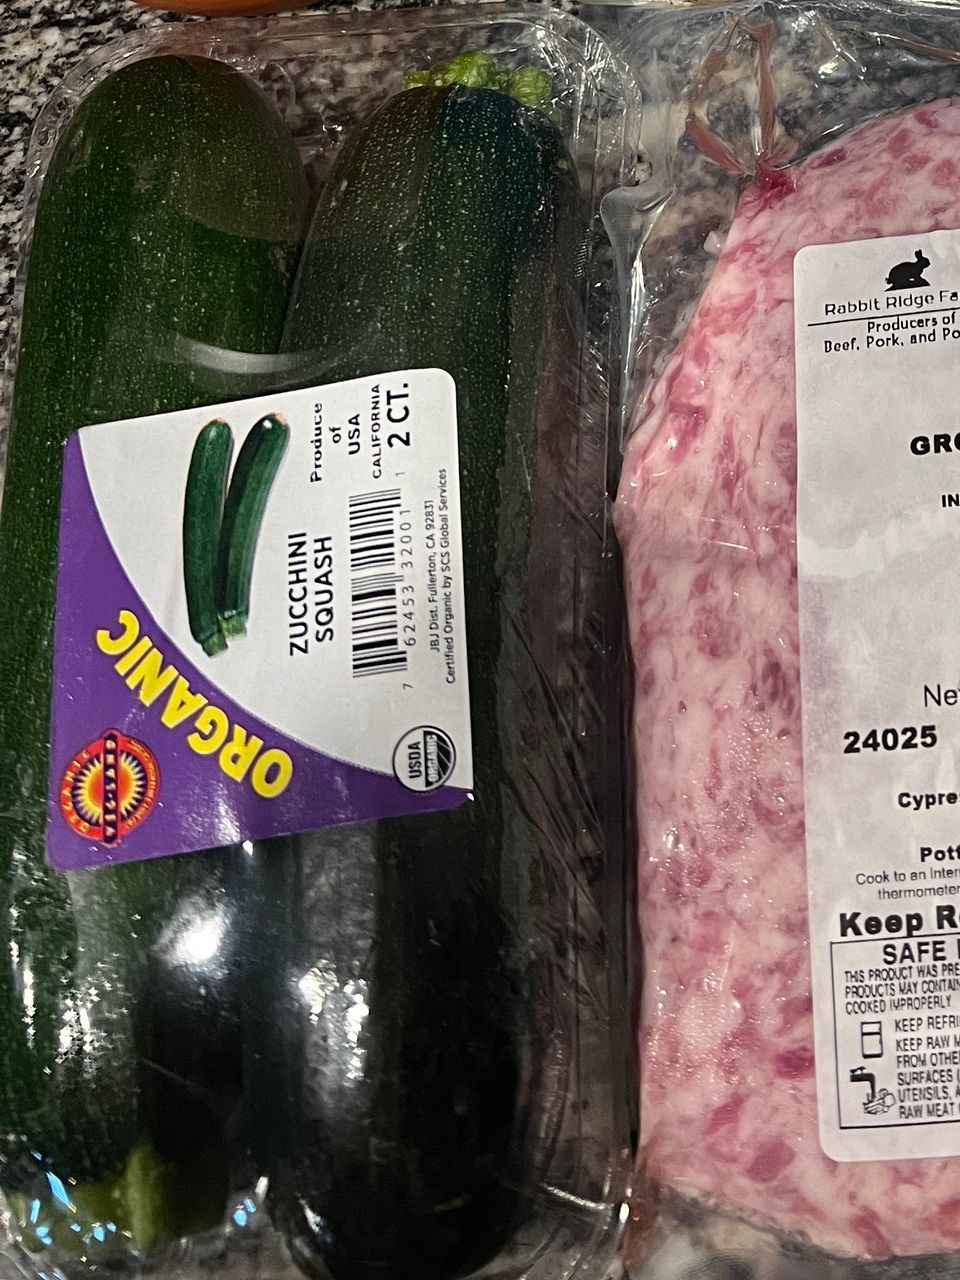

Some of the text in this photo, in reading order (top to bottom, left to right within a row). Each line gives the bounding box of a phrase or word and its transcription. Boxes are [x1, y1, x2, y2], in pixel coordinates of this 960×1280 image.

[824, 297, 880, 315] Rabbit
[886, 293, 934, 309] Ridge
[867, 311, 955, 333] Producers of
[866, 332, 903, 348] Pork,
[910, 328, 935, 344] and
[386, 382, 411, 448] 2 CT.
[310, 402, 323, 483] Produce
[328, 425, 342, 445] of
[348, 412, 362, 456] USA
[371, 383, 381, 480] CALIFORNIA
[400, 508, 413, 570] 32001
[314, 535, 335, 643] SQUASH
[424, 499, 441, 654] JBJ Dist. Fullerton, CA 92831
[438, 468, 457, 685] Certified Organic by SCS Global Services
[288, 532, 309, 657] ZUCCHINI
[402, 584, 417, 648] 62453
[96, 609, 295, 800] ORGANIC
[843, 724, 937, 753] 24025
[408, 741, 422, 779] USDA
[855, 869, 890, 885] Cook
[893, 870, 906, 882] to
[910, 871, 926, 881] an
[877, 883, 960, 899] thermometer
[839, 912, 922, 936] Keep
[882, 940, 946, 965] SAFE
[894, 1017, 922, 1032] KEEP
[895, 1037, 922, 1051] KEEP
[926, 1035, 949, 1049] RAW
[896, 1053, 926, 1068] FROM
[897, 1068, 952, 1086] SURFACES
[898, 1105, 922, 1119] RAW
[926, 1101, 954, 1117] MEAT
